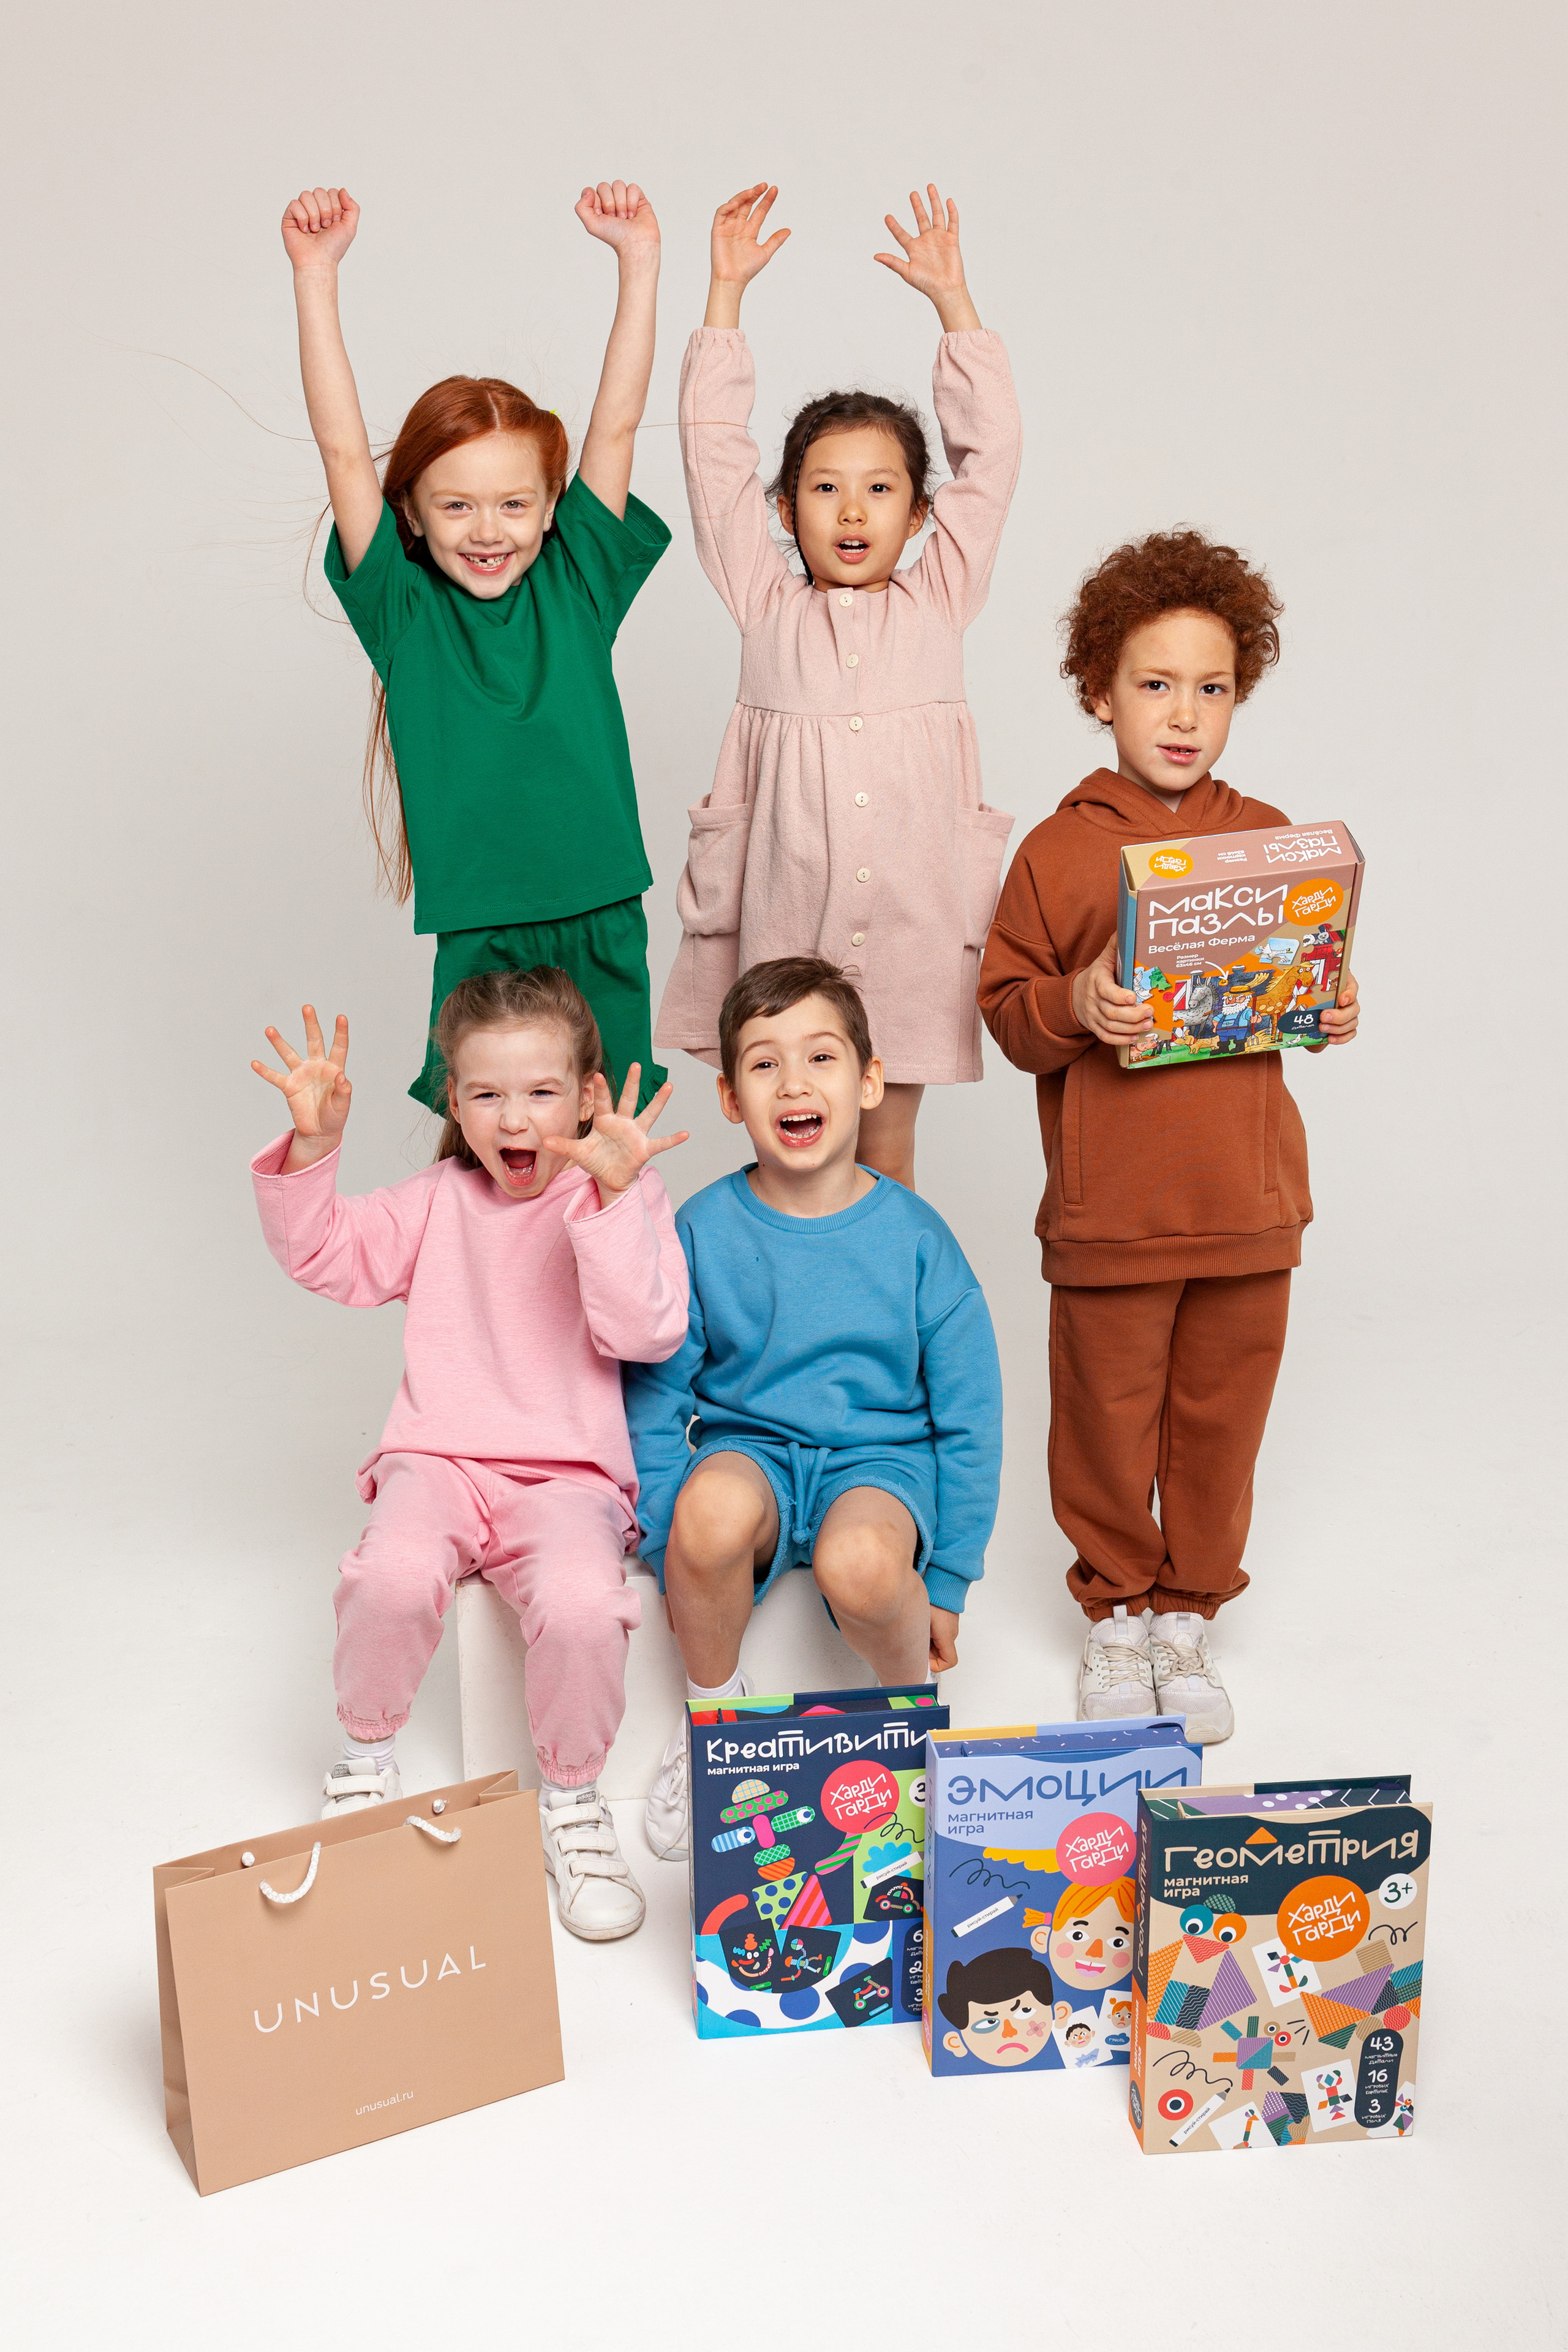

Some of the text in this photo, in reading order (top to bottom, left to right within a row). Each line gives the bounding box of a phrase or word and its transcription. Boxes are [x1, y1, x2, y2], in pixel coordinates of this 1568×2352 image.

[1148, 935, 1256, 954] Весёлая Ферма
[1294, 1014, 1314, 1024] 48
[707, 1762, 800, 1776] магнитная игра
[948, 1811, 1033, 1823] магнитная
[948, 1824, 985, 1836] игра
[1164, 1830, 1419, 1872] Геометрия
[876, 1861, 908, 1880] рисуй-стирай
[1164, 1874, 1249, 1887] магнитная
[1164, 1887, 1200, 1899] игра
[1384, 1882, 1413, 1903] 3+
[967, 1907, 999, 1928] рисуй-стирай
[254, 1945, 486, 2033] UNUSUAL
[1370, 2036, 1393, 2051] 43
[1368, 2068, 1388, 2082] 16
[355, 2090, 413, 2115] unusual.ru
[1368, 2099, 1381, 2113] 3
[1183, 2107, 1210, 2134] рисуй-стирай
